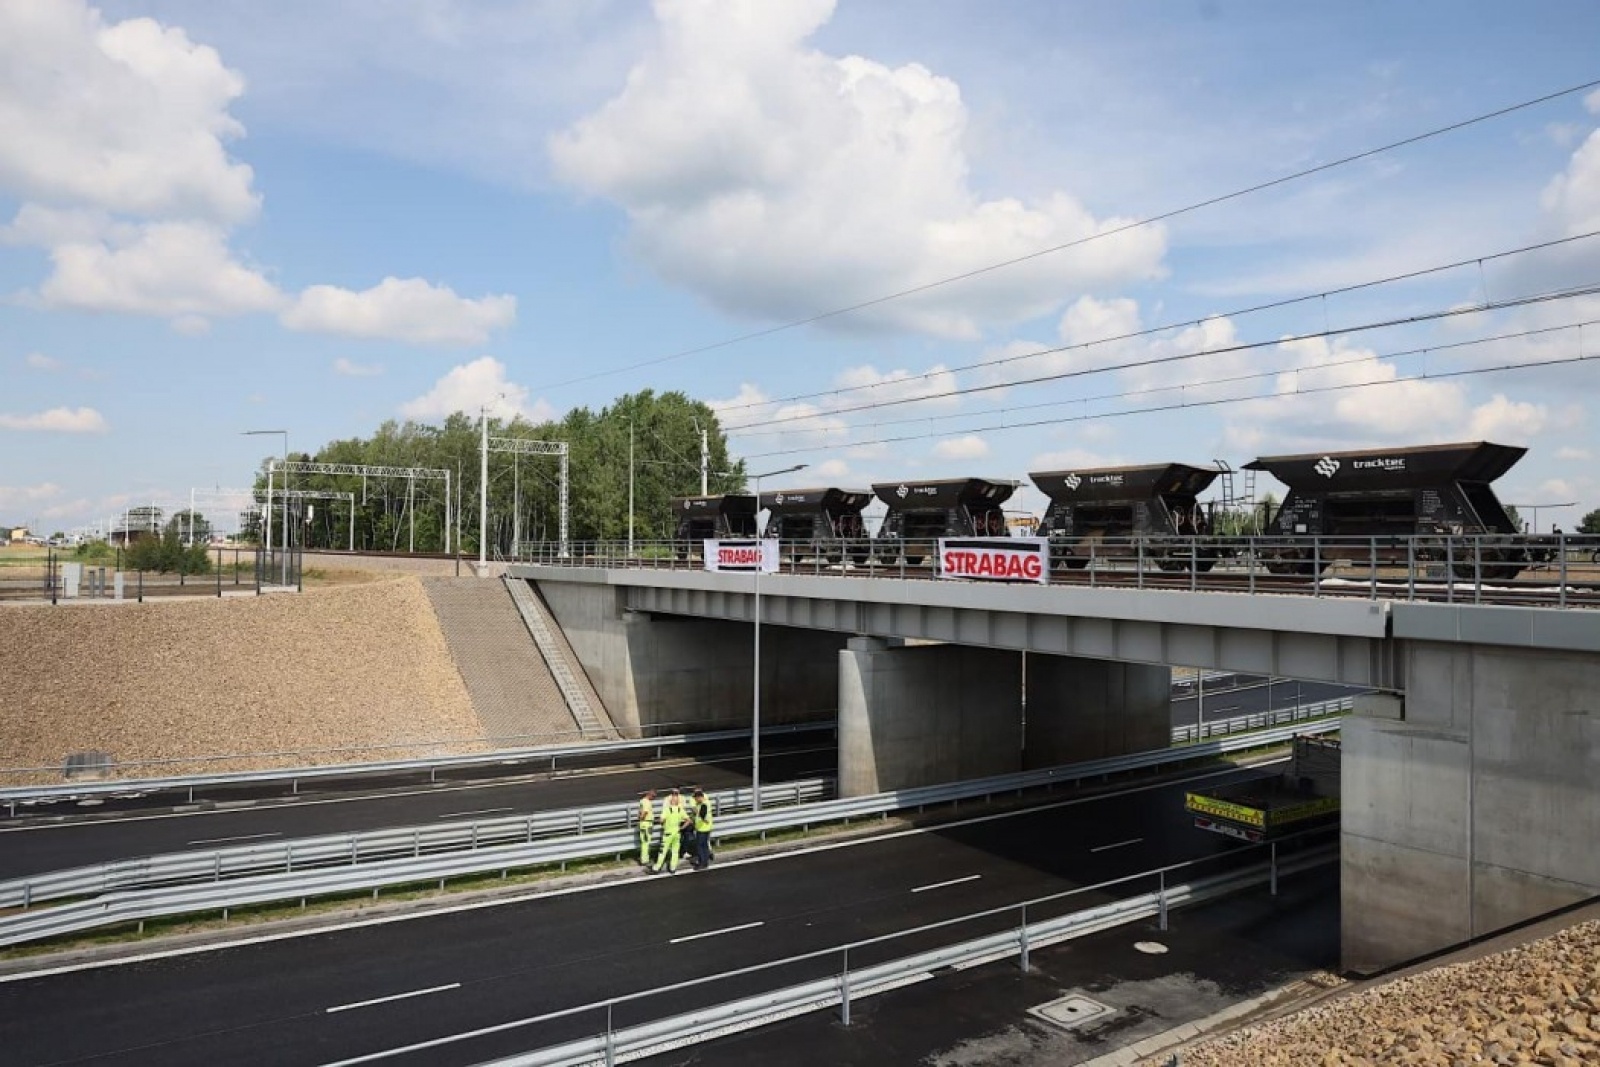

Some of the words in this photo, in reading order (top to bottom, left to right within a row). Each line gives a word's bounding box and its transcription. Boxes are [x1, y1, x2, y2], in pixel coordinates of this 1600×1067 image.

[1353, 458, 1405, 468] tracktec
[718, 549, 762, 564] STRABAG
[945, 552, 1041, 578] STRABAG
